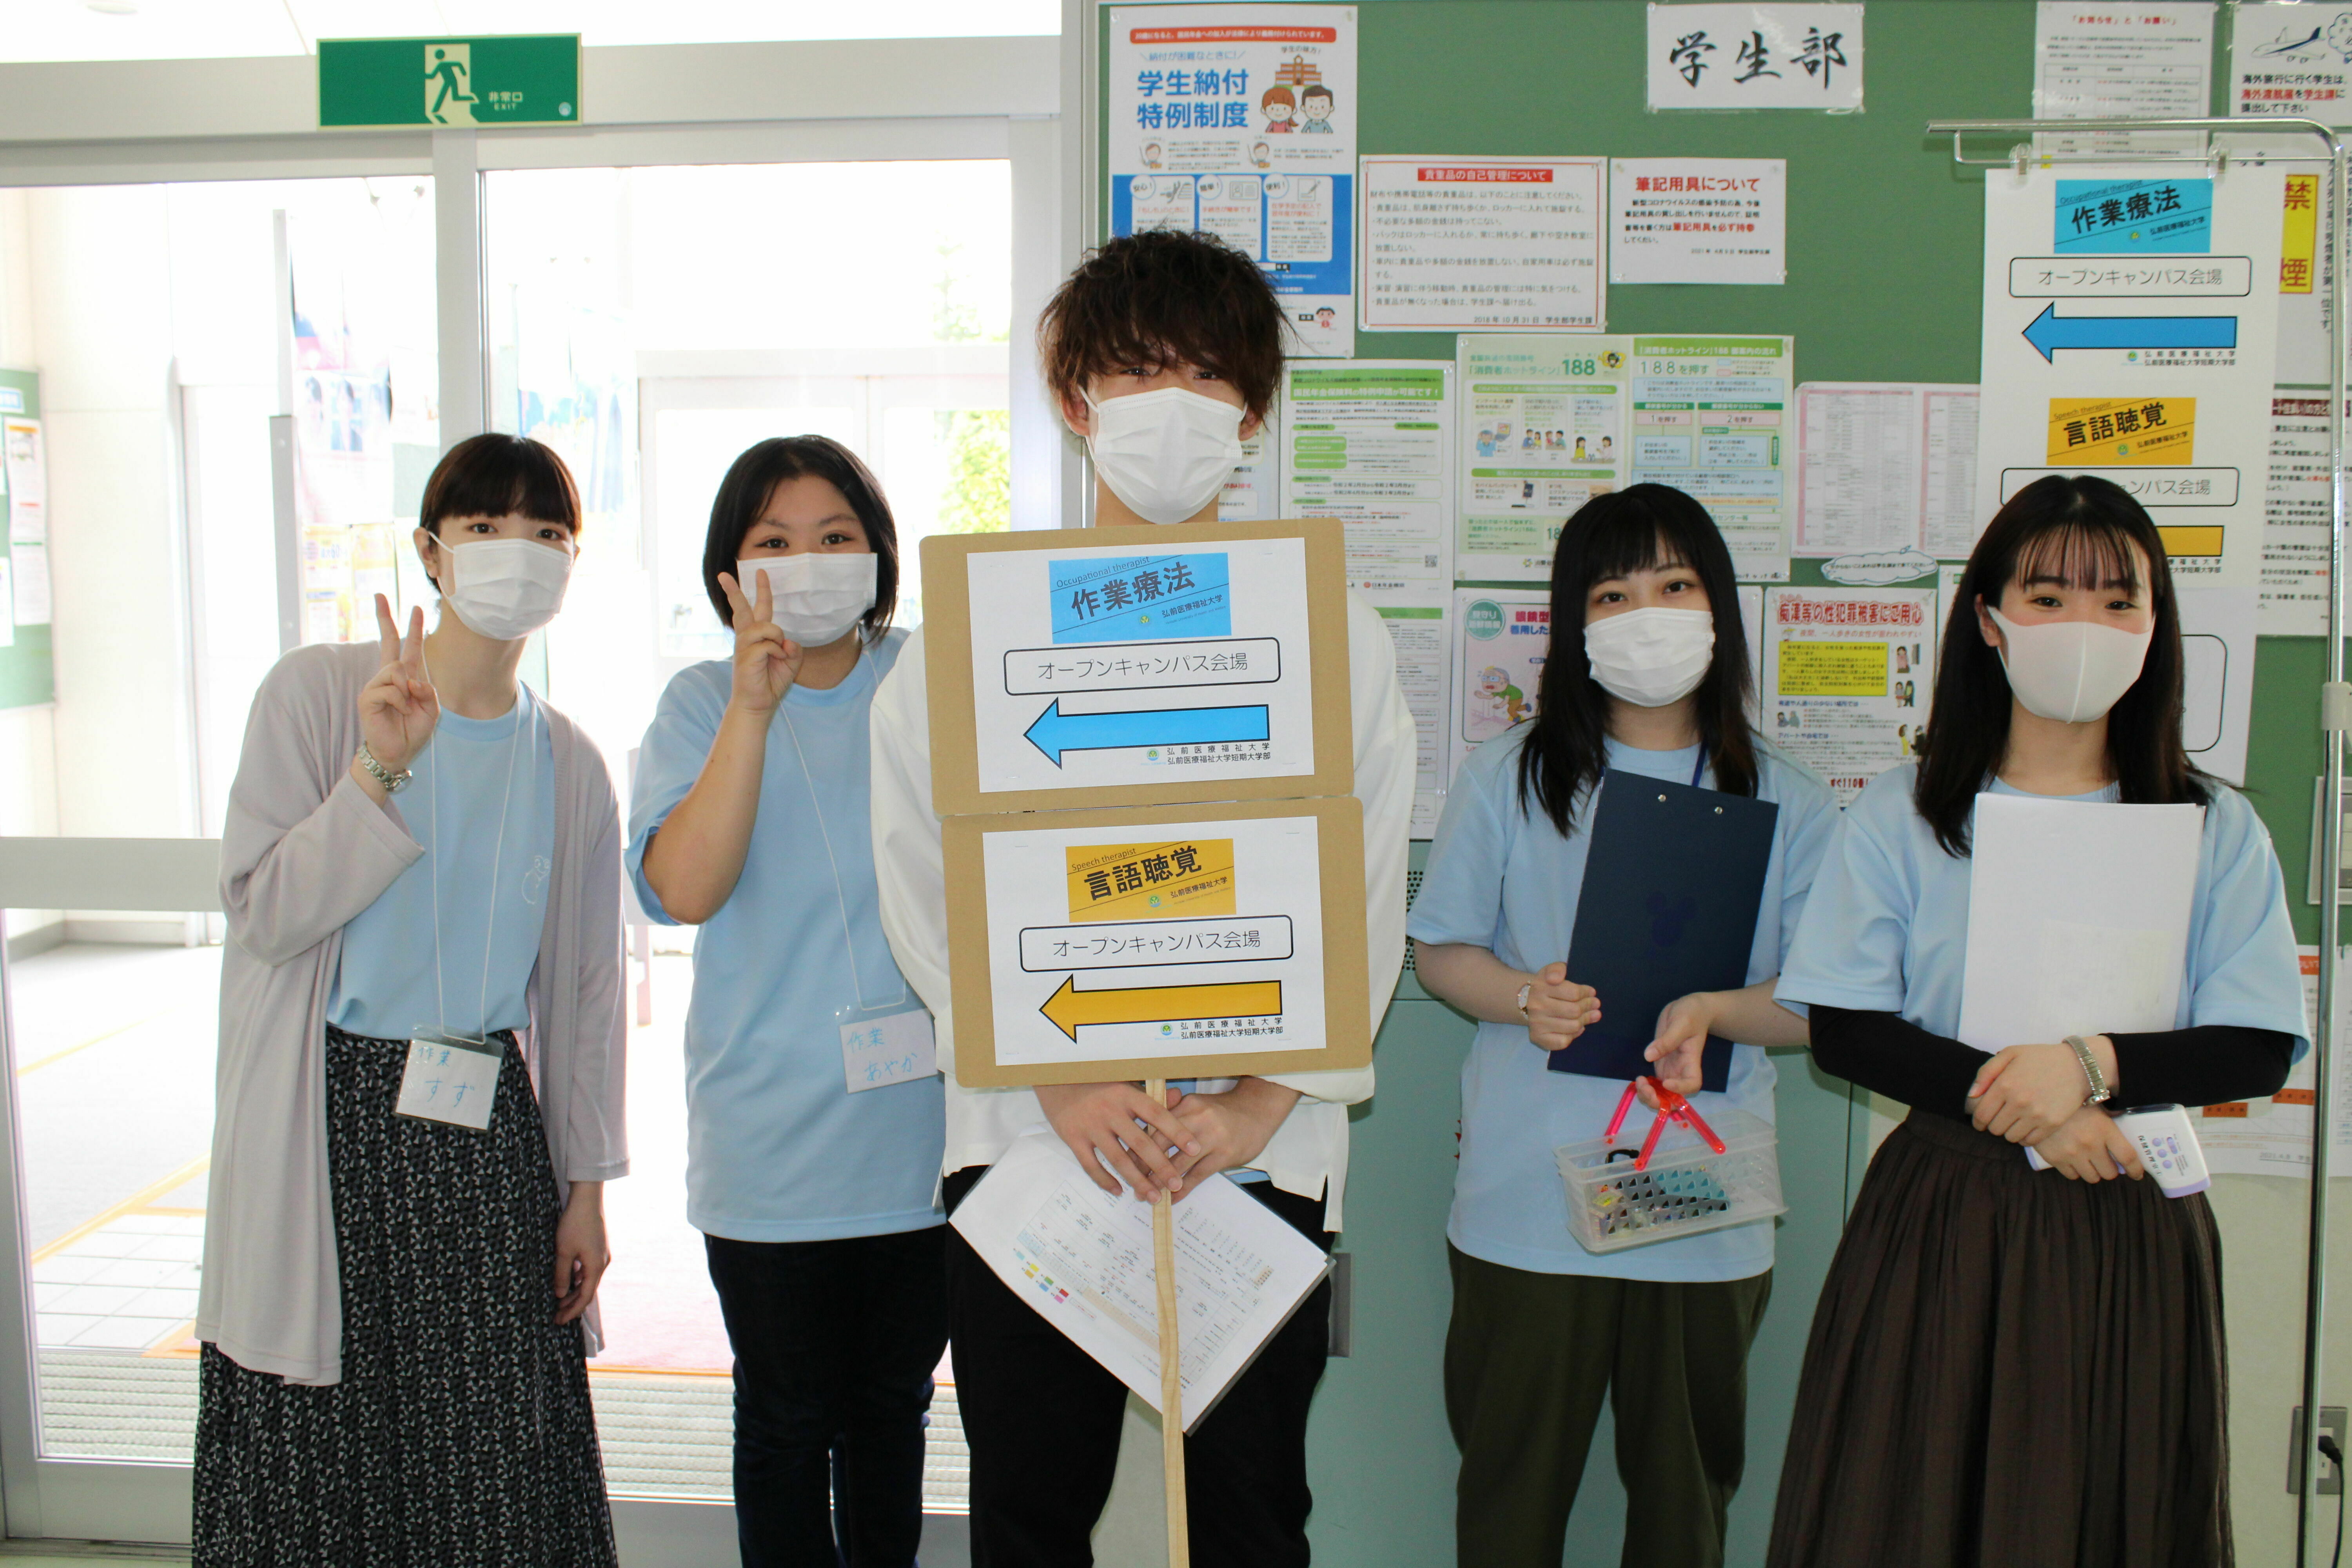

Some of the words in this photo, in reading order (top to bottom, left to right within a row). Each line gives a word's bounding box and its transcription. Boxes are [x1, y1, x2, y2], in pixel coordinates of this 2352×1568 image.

[1669, 27, 1847, 89] 学生部
[1137, 68, 1249, 97] 学生納付
[489, 91, 523, 102] 非常口
[494, 103, 517, 111] EXIT
[1137, 102, 1249, 129] 特例制度
[1425, 169, 1546, 181] 貴重品の自己管理について
[1635, 176, 1761, 192] 筆記用具について
[2072, 185, 2182, 235] 作業療法
[2038, 269, 2223, 286] オープンキャンパス会場
[1562, 358, 1596, 376] 188
[2063, 401, 2167, 448] 言語聴覚
[1055, 566, 1112, 588] Occupational
[1111, 555, 1151, 575] therapist
[1071, 561, 1196, 621] 作業療法
[1161, 593, 1223, 618] 弘前医療福祉大学
[1778, 601, 1924, 625] 痴漢等の性犯罪被害にご用心
[1037, 652, 1248, 680] オープンキャンパス会場
[1166, 742, 1270, 756] 弘前医療福祉大学
[1166, 751, 1271, 766] 弘前医療福祉大学短期大学部
[1071, 854, 1100, 873] Speech
[1100, 847, 1137, 865] therapist
[1083, 845, 1202, 901] 言語聴覚
[1170, 876, 1228, 899] 弘前医療福祉大学
[1053, 929, 1261, 957] オープンキャンパス会場
[1180, 1016, 1283, 1030] 弘前医療福祉大学
[1180, 1025, 1284, 1040] 弘前医療福祉大学短期大学部
[846, 1026, 884, 1053] 作業
[418, 1046, 450, 1067] 作業
[864, 1052, 918, 1082] あやか
[425, 1077, 475, 1107] すず
